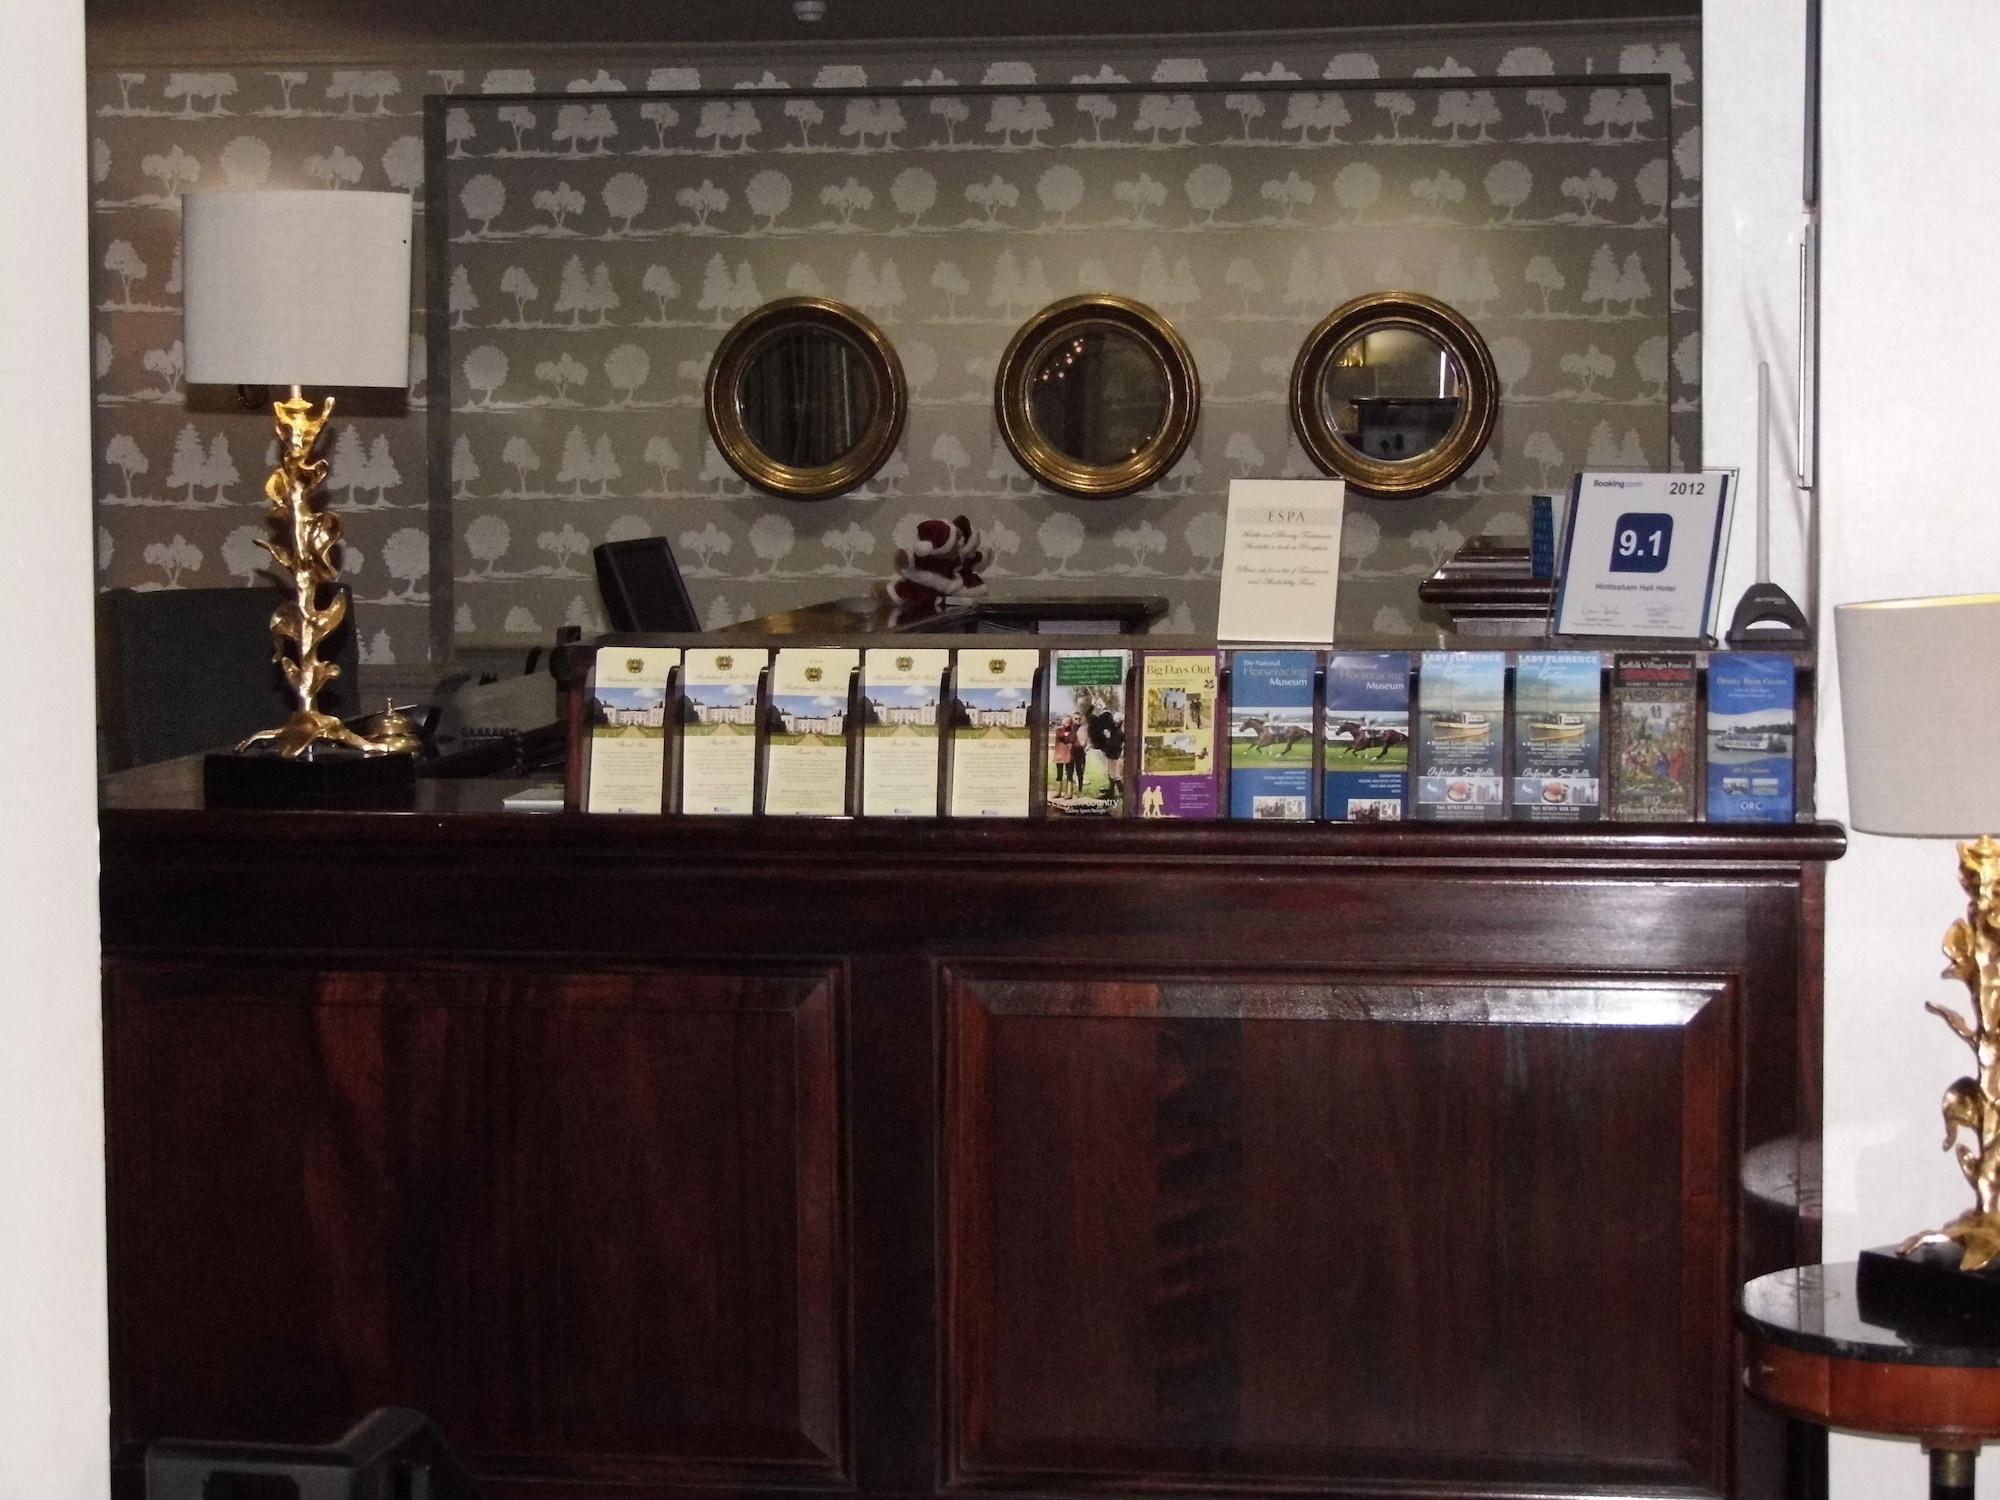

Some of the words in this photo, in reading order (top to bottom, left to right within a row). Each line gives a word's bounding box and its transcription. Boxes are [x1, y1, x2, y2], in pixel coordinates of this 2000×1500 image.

[1593, 479, 1643, 489] Booking.com
[1669, 482, 1705, 496] 2012
[1267, 511, 1305, 522] ESPA
[1618, 529, 1663, 557] 9.1
[1595, 583, 1637, 592] Hintlesham
[1639, 583, 1654, 592] Hall
[1656, 584, 1676, 593] Hotel
[1518, 655, 1544, 663] LADY
[1546, 655, 1598, 663] FLORENCE
[1147, 665, 1163, 677] Big
[1164, 665, 1189, 677] Days
[1191, 665, 1211, 674] Out
[1243, 667, 1308, 679] Horseracing
[1339, 670, 1404, 682] Horseracing
[1269, 678, 1308, 686] Museum
[1366, 682, 1405, 690] Museum
[1740, 802, 1763, 811] ORC
